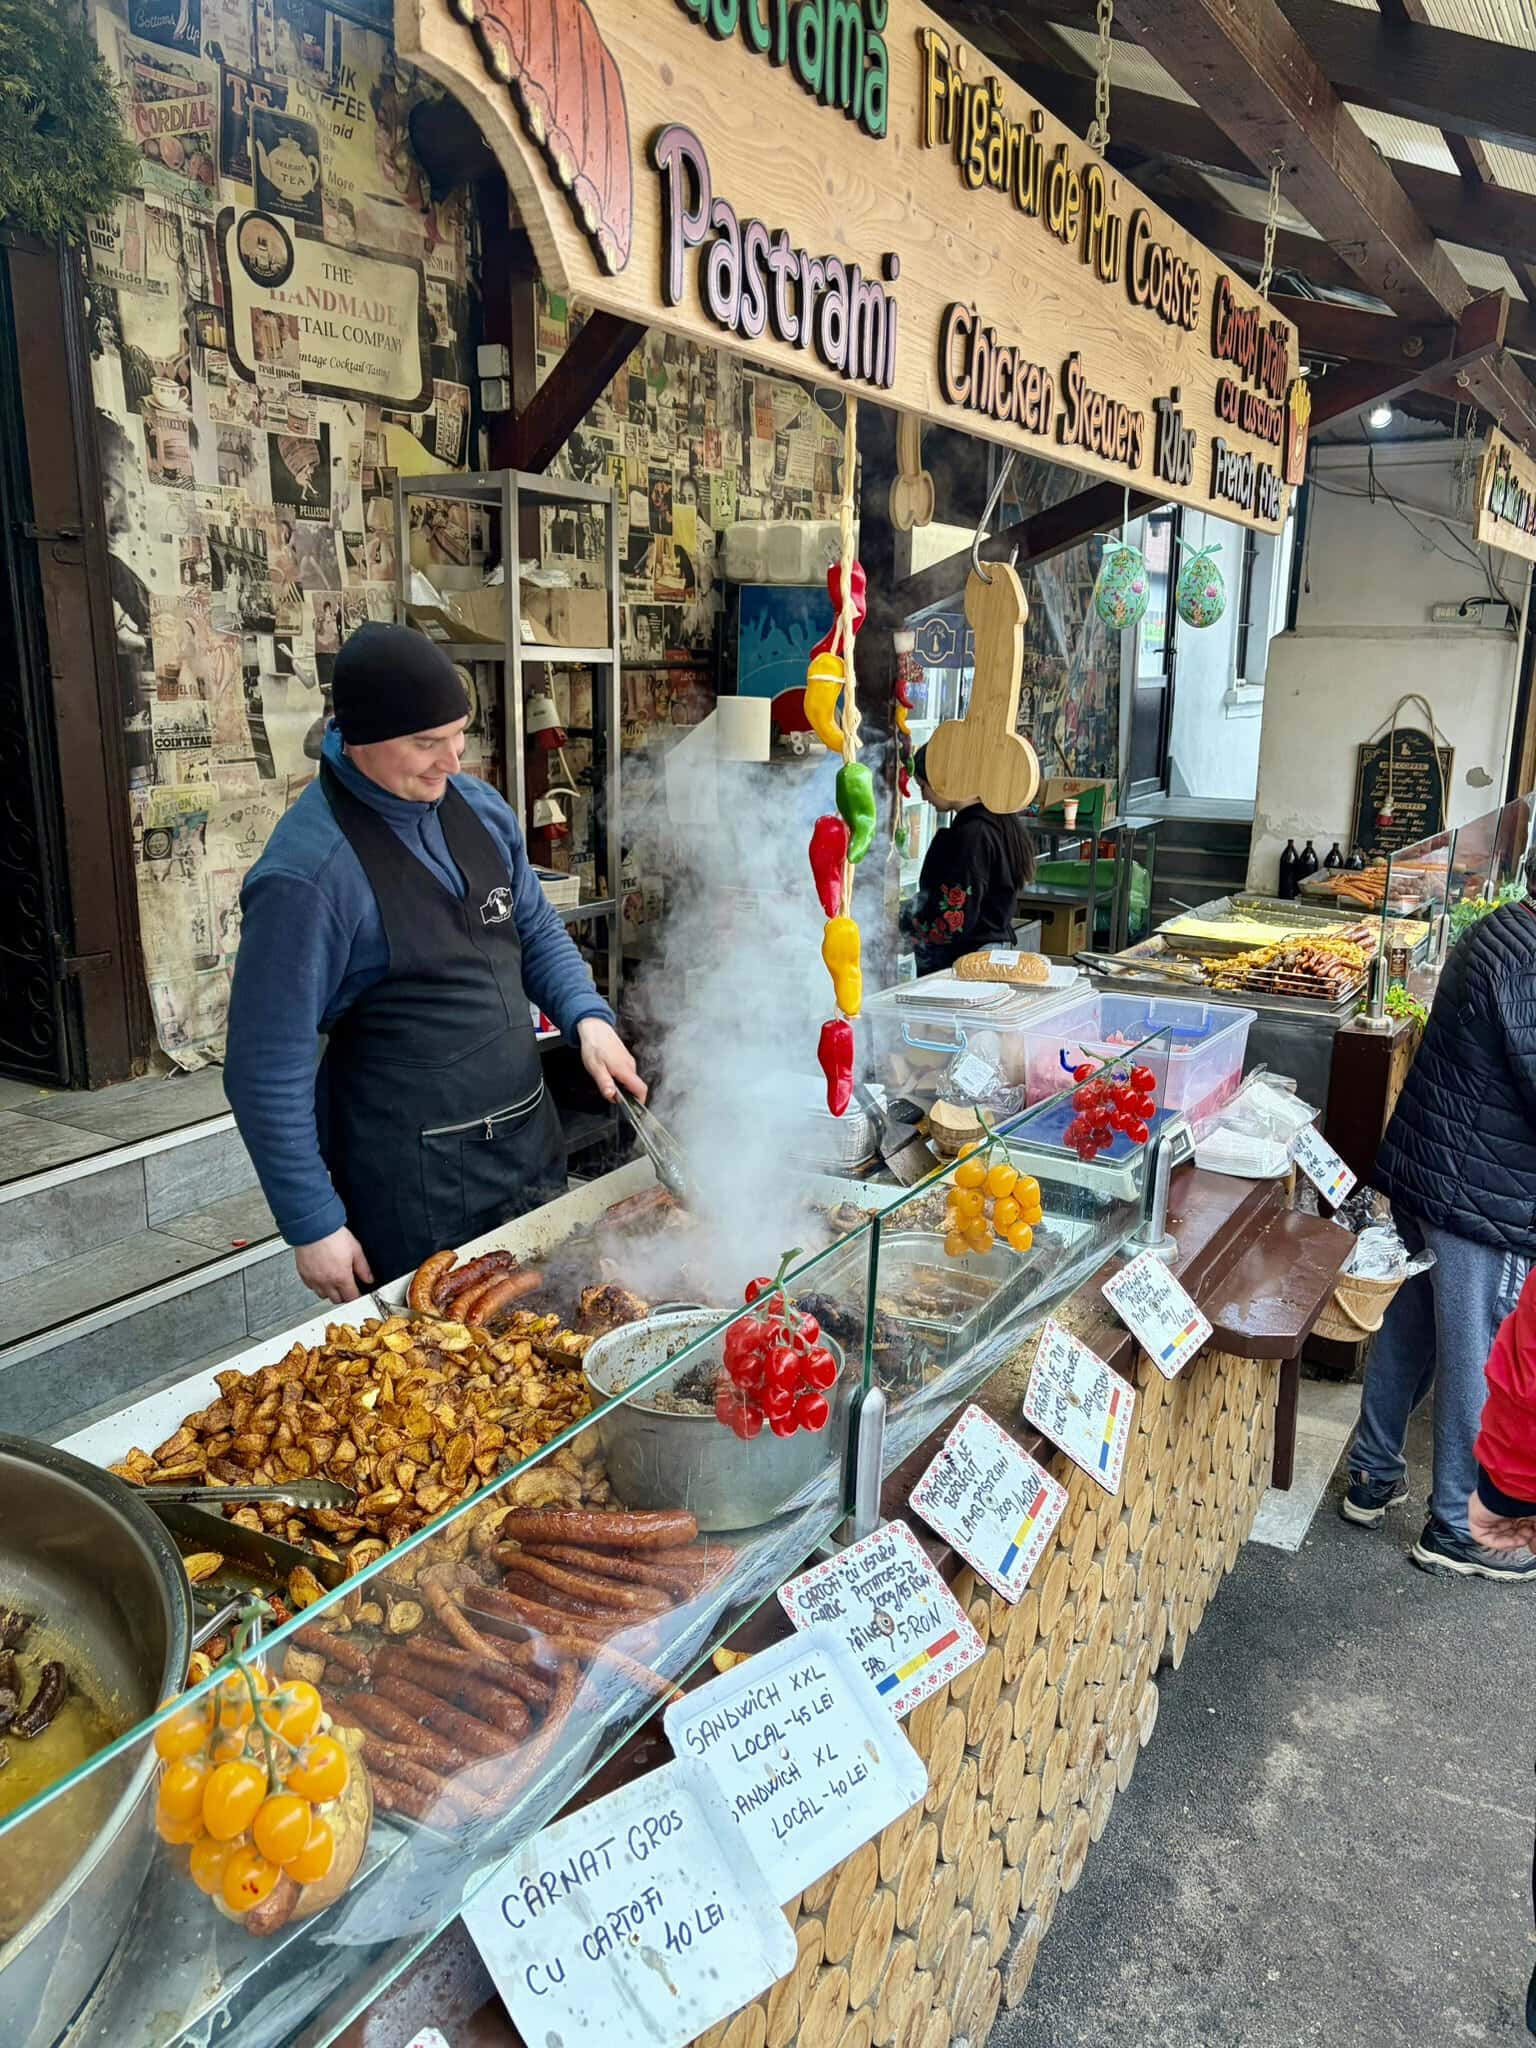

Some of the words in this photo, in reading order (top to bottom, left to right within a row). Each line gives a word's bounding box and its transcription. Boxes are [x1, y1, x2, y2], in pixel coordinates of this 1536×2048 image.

[135, 100, 210, 140] CORDIAL
[915, 27, 1044, 218] Frigărui
[1043, 143, 1080, 245] de
[1079, 163, 1121, 284] Pui
[280, 173, 306, 186] TEA
[91, 229, 115, 249] one
[648, 122, 901, 390] Pastrami
[96, 262, 143, 286] Mirinda
[322, 262, 354, 285] THE
[1126, 207, 1202, 331] Coaste
[938, 301, 1055, 435] Chicken
[1056, 351, 1145, 470] Skewers
[1215, 377, 1240, 424] cu
[1152, 386, 1197, 486] Ribs
[1209, 436, 1256, 511] French
[954, 1504, 986, 1543] LAMB
[896, 1623, 910, 1645] 5
[908, 1601, 943, 1640] RON
[789, 1665, 826, 1692] XXL
[730, 1723, 786, 1763] LOCAL
[812, 1743, 839, 1768] XL
[770, 1797, 824, 1840] LOCAL
[500, 1836, 617, 1931] CÂRNAT
[627, 1809, 684, 1861] GROS
[525, 1957, 566, 1997] CU
[582, 1885, 665, 1962] CARTOFI
[664, 1921, 694, 1954] 40
